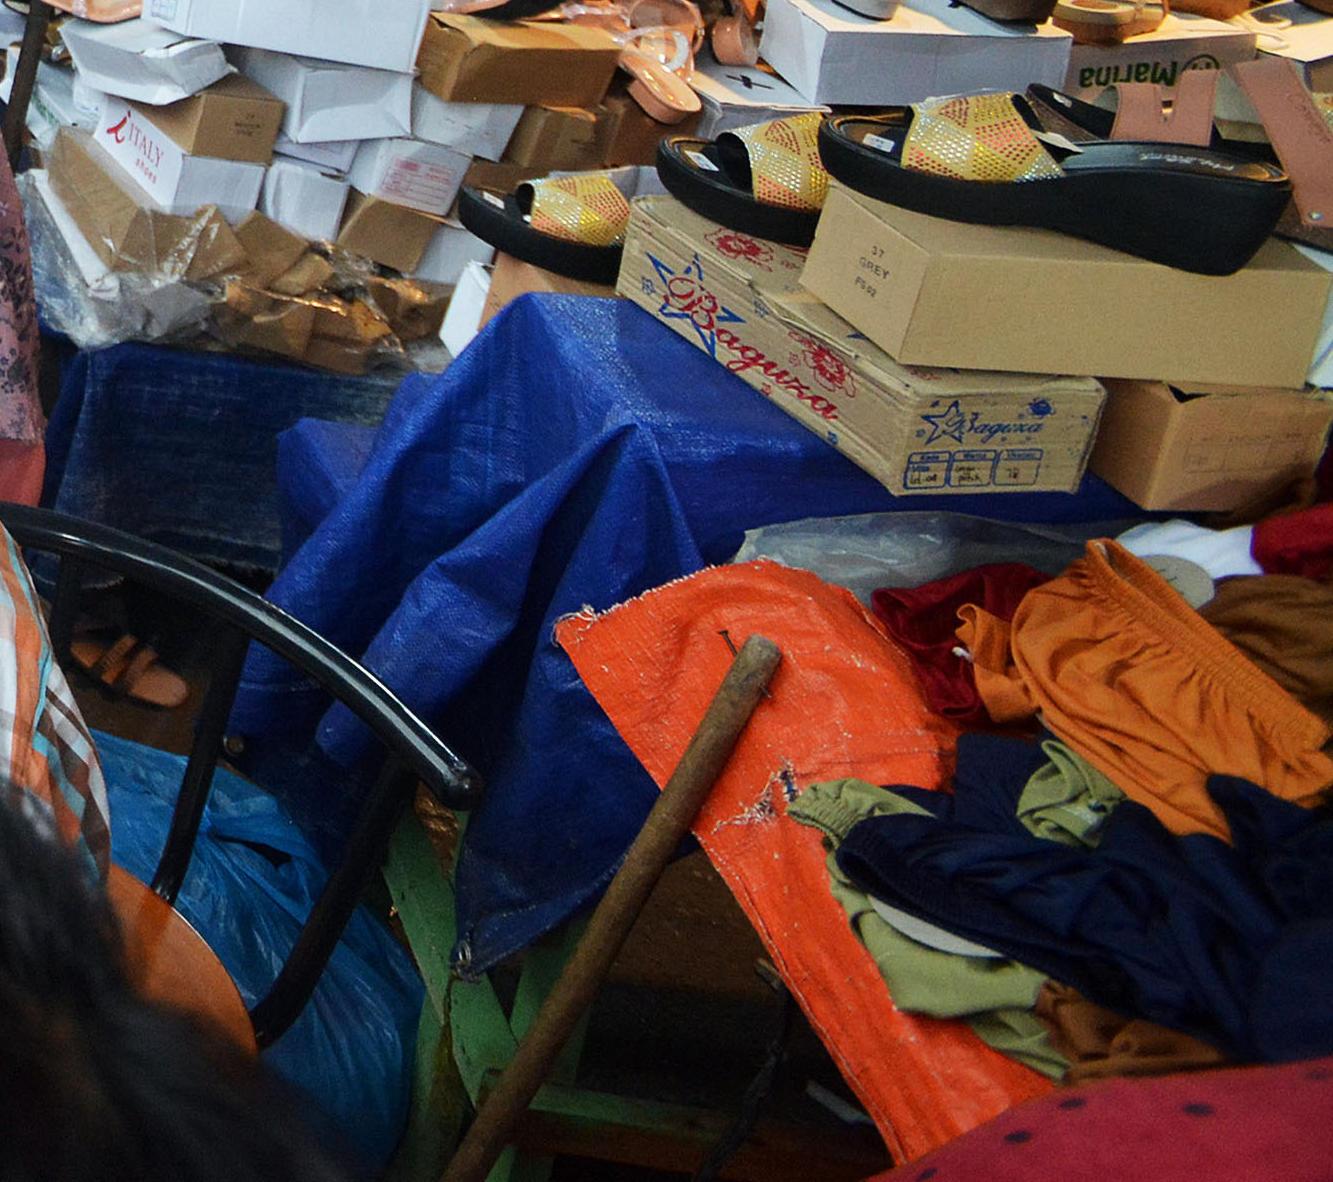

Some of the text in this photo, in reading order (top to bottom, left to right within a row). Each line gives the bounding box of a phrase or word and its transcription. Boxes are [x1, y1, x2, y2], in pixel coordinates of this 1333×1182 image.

[1079, 61, 1177, 88] Marina
[128, 123, 165, 168] ITALY
[859, 257, 891, 281] GREY
[663, 275, 839, 420] Baguza
